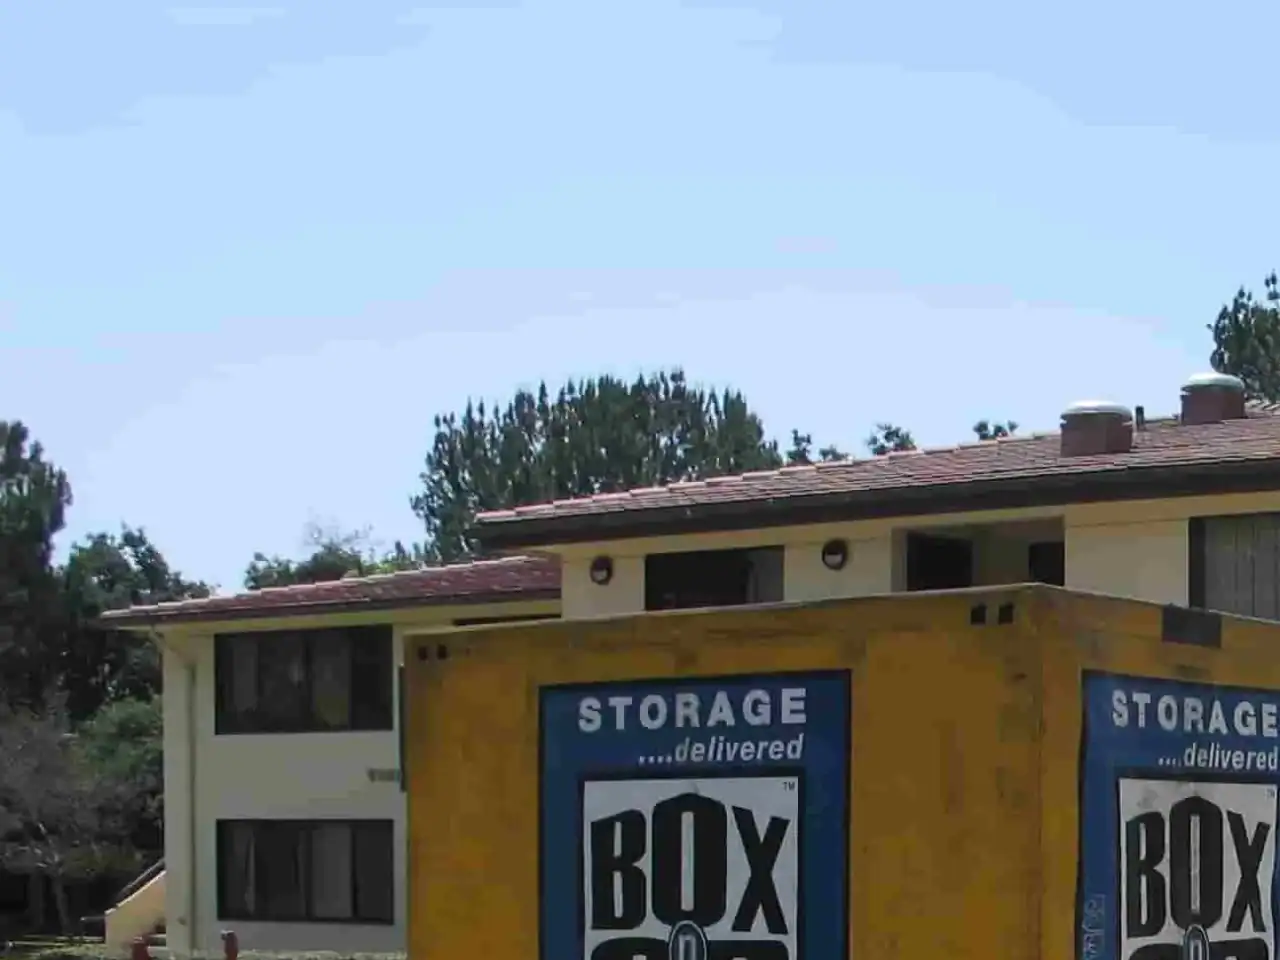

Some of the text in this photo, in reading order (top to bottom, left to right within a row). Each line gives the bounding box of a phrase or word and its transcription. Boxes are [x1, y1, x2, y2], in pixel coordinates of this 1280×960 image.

[577, 688, 807, 733] STORAGE
[1112, 689, 1278, 738] STORAGE
[590, 792, 790, 935] BOX
[1126, 796, 1270, 938] BOX
